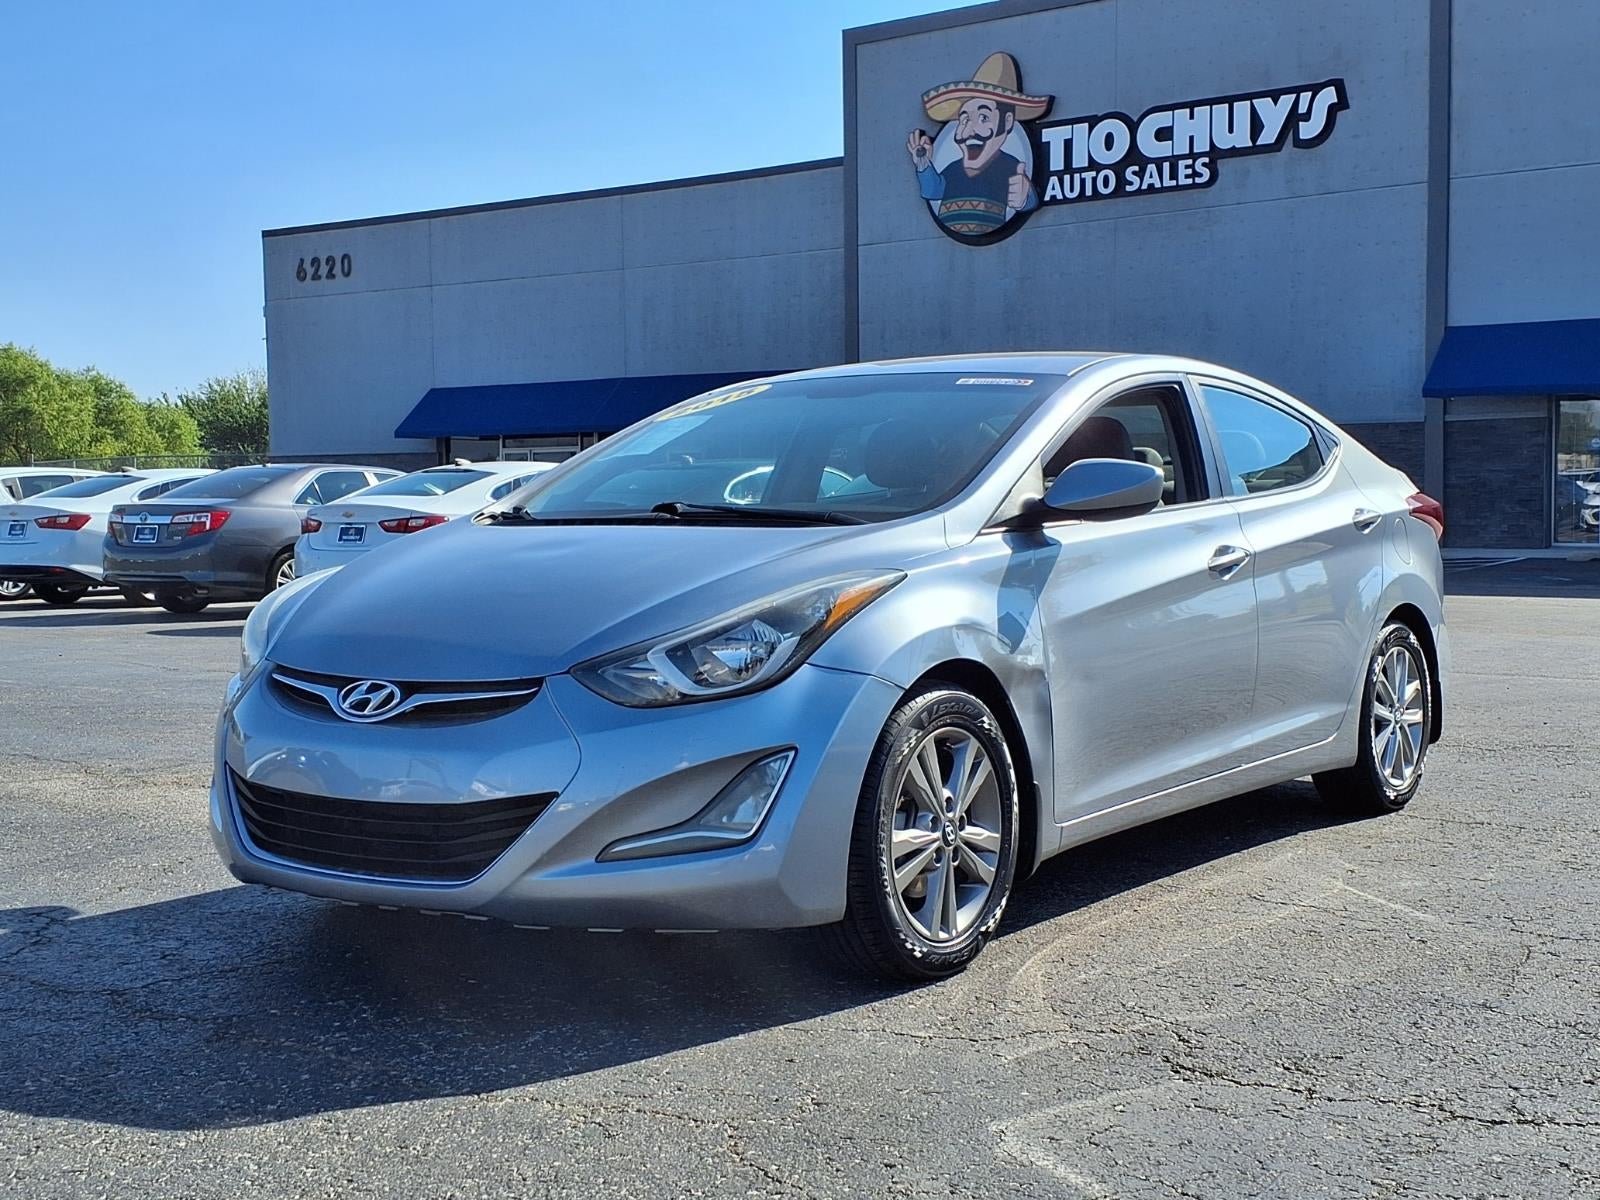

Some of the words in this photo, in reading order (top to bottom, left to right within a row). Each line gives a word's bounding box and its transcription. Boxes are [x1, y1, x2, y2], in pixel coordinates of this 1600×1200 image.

[1041, 118, 1131, 171] TIO
[1136, 86, 1338, 159] CHUY'S
[1043, 168, 1117, 201] AUTO
[1124, 156, 1211, 193] SALES
[296, 253, 352, 282] 6220
